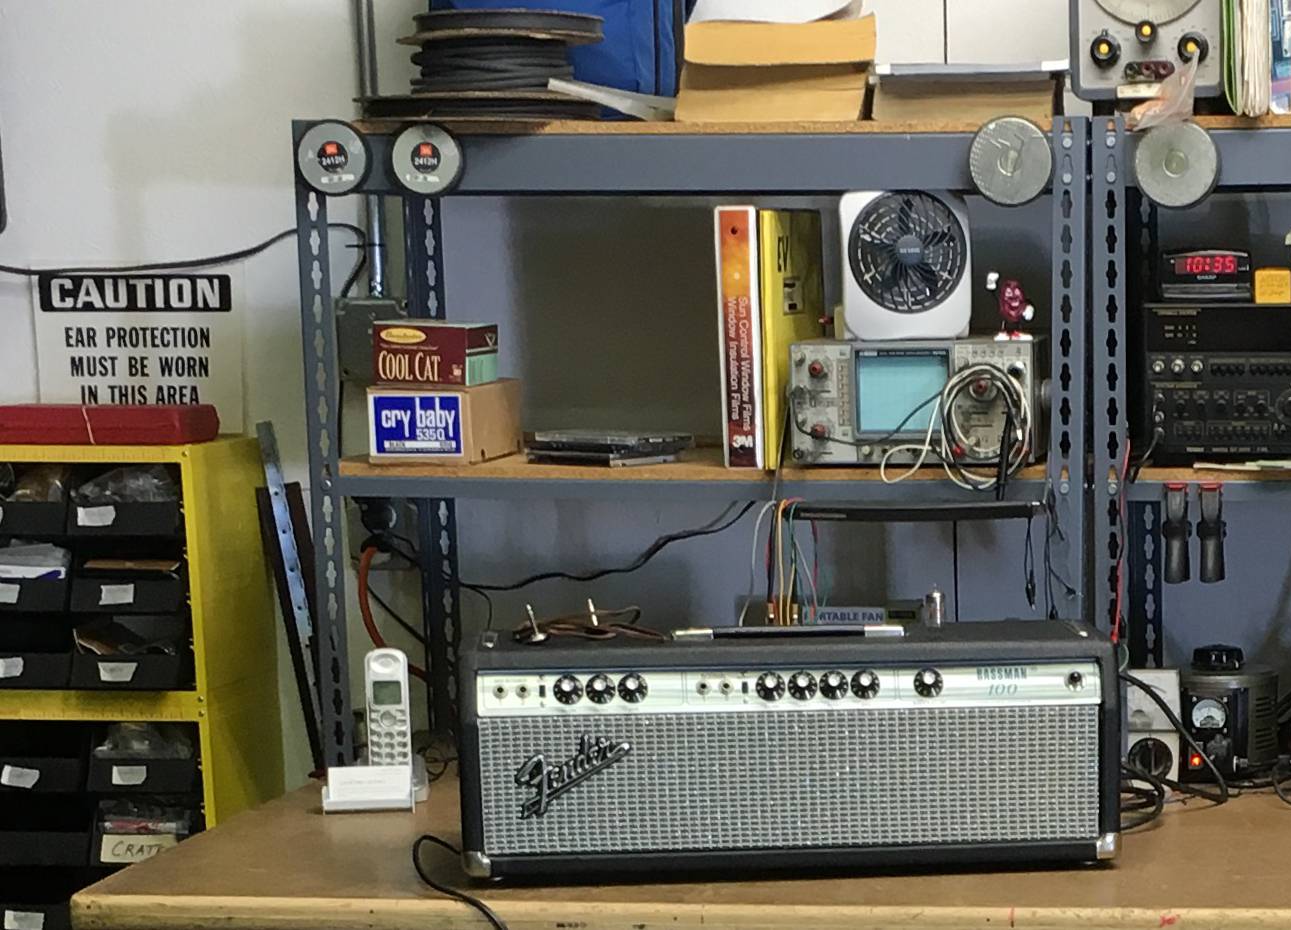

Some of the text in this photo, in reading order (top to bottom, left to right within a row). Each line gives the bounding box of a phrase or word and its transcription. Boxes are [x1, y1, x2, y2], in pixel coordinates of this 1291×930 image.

[1184, 256, 1234, 274] 10:35
[50, 278, 220, 308] CAUTION
[64, 327, 210, 348] EAR PROTECTION
[70, 356, 209, 377] MUST BE WORN
[378, 351, 440, 381] COOL CAT
[728, 298, 741, 420] Window Insulation Films
[739, 297, 753, 431] Sun Control Window Films
[81, 385, 200, 405] IN THIS AREA
[381, 397, 455, 437] cry baby
[416, 428, 446, 440] 535Q
[732, 435, 753, 447] 3M
[862, 611, 884, 622] FAN
[976, 666, 1027, 680] BASSMAN
[988, 684, 1018, 696] 100
[515, 733, 631, 819] Fender
[111, 840, 162, 857] CRAT
